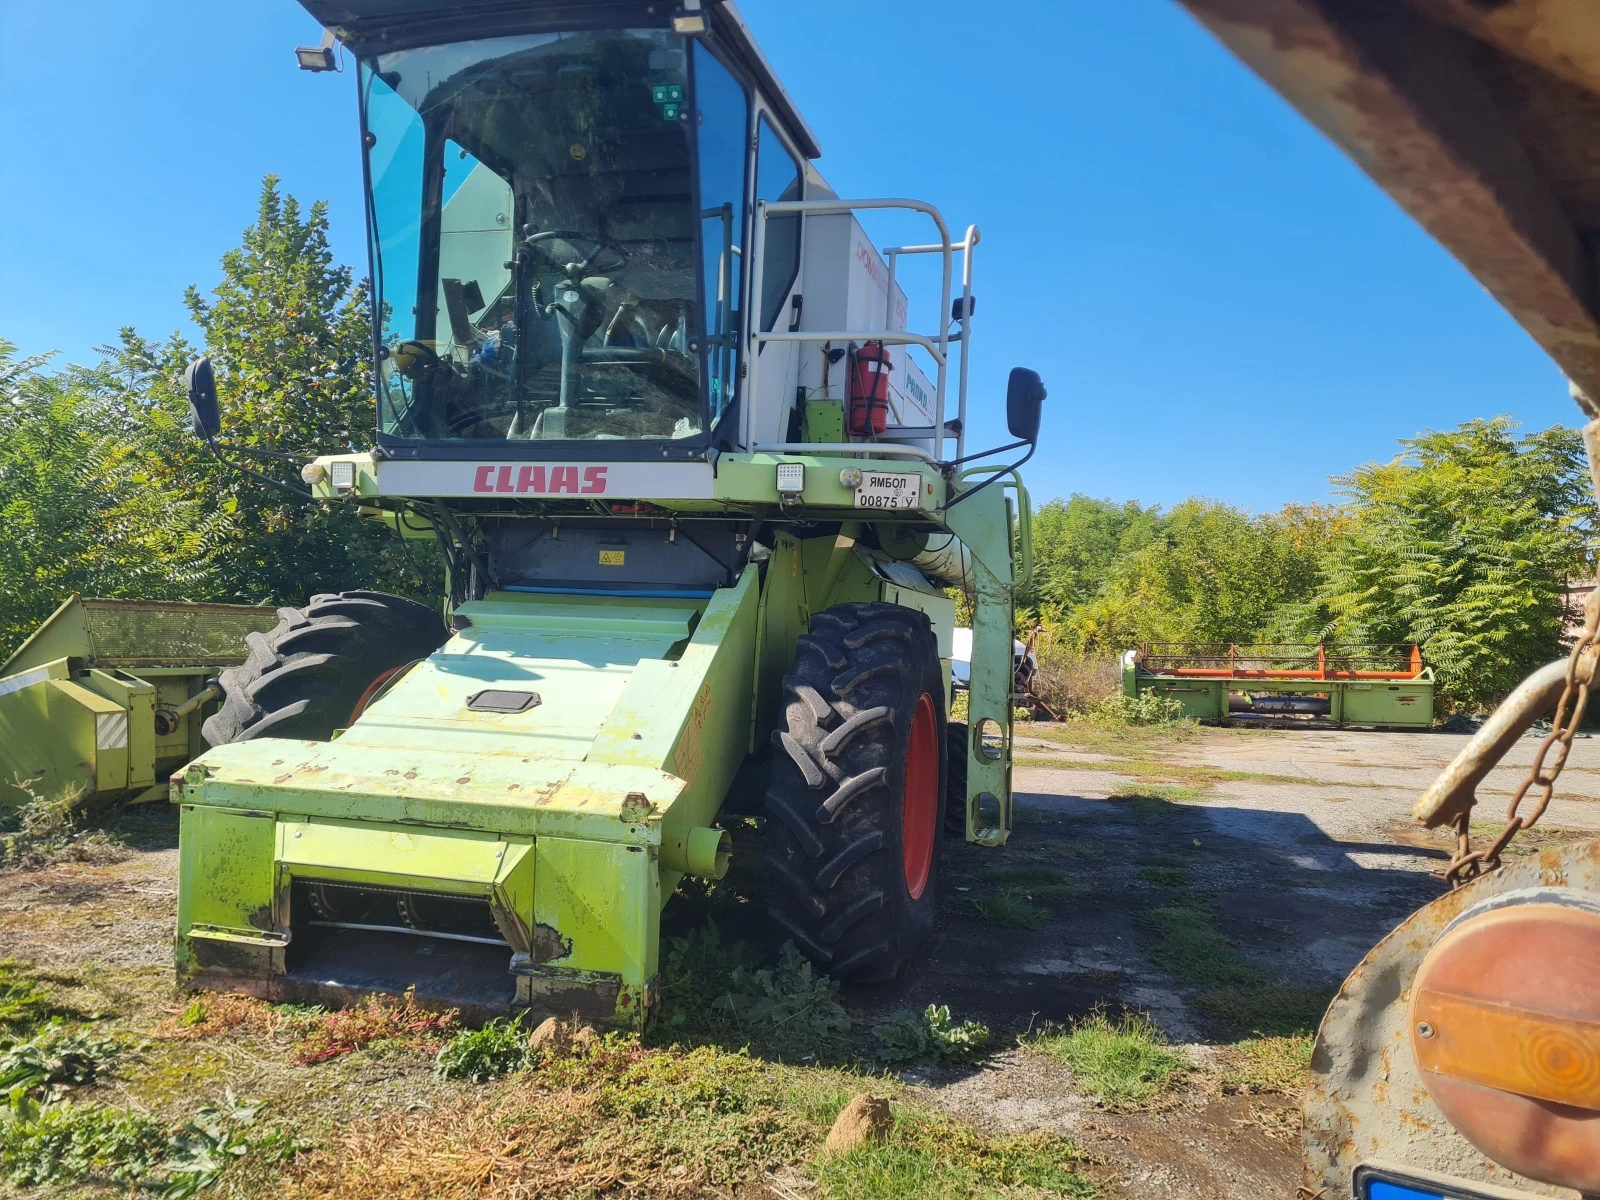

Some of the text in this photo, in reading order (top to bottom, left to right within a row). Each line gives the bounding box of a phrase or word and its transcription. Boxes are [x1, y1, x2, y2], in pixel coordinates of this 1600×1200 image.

[473, 466, 608, 493] CLAAS
[870, 477, 906, 488] ЯМБОЛ
[860, 495, 897, 508] 00875
